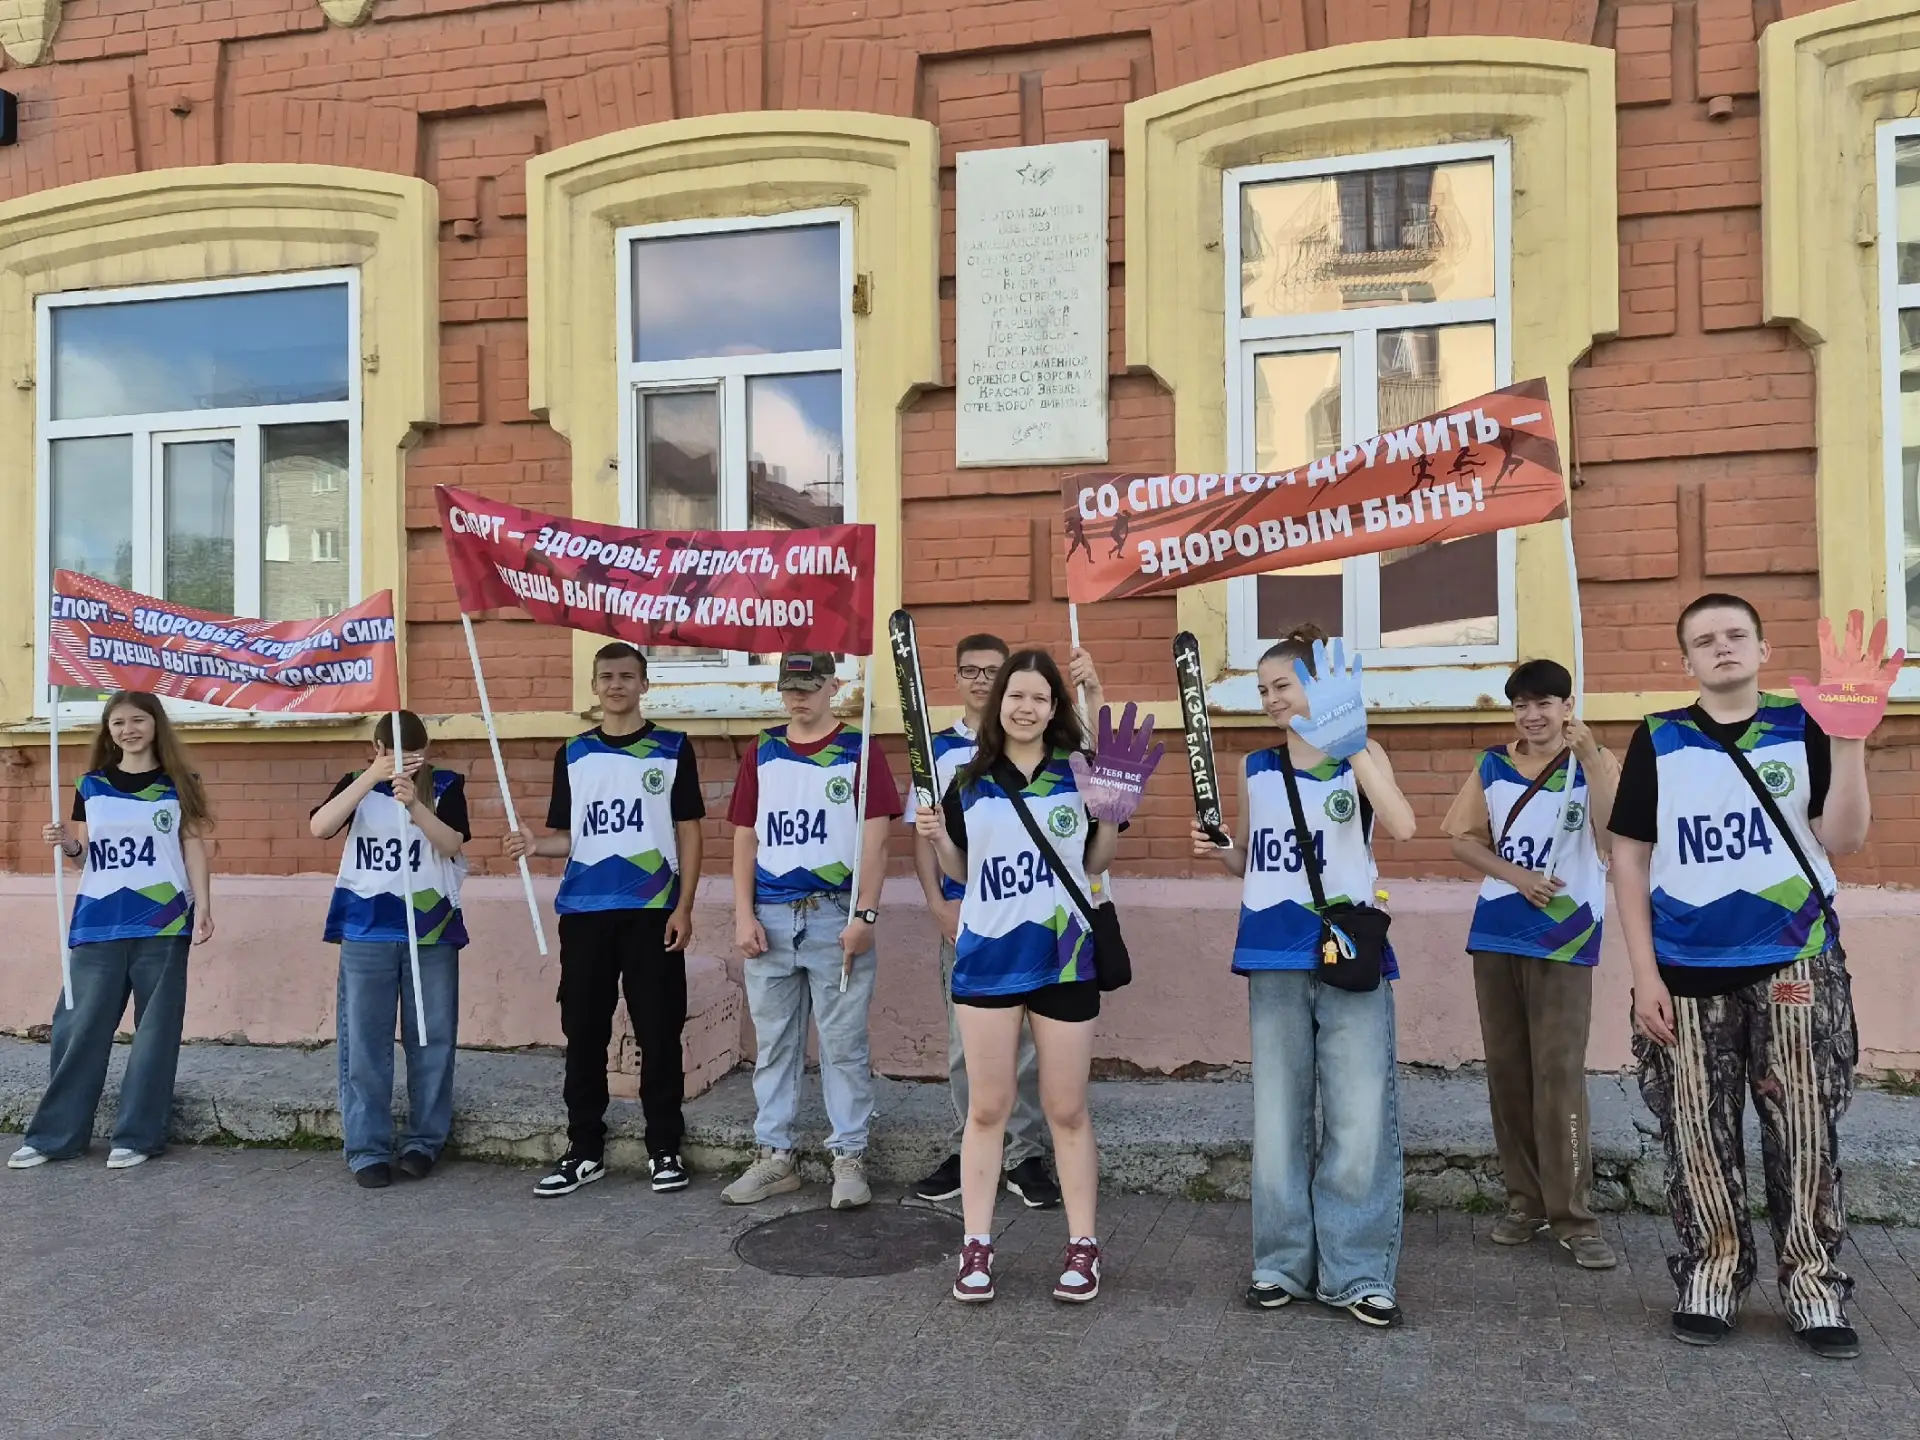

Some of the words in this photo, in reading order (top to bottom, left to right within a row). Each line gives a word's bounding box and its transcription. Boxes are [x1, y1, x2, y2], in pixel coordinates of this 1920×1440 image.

[1079, 484, 1119, 520] СО
[1307, 408, 1499, 487] ДРУЖИТЬ
[450, 506, 505, 544] СПОРТ
[534, 527, 663, 578] ЗДОРОВЬЕ,
[668, 547, 779, 579] КРЕПОСТЬ,
[1138, 505, 1353, 576] ЗДОРОВЫМ
[1362, 477, 1485, 532] БЫТЬ!
[494, 561, 559, 604] УДЕШЬ
[563, 578, 691, 624] ВЫГЛЯДЕТЬ
[695, 597, 814, 626] КРАСИВО!
[51, 596, 109, 622] СПОРТ
[134, 608, 244, 648] ЗДОРОВЬЕ,
[89, 637, 160, 667] БУДЕШЬ
[274, 659, 373, 686] КРАСИВО!
[1819, 692, 1878, 704] СДАВАЙСЯ!
[1842, 683, 1856, 691] НЕ
[1090, 776, 1142, 794] ПОЛУЧИТСЯ!
[1094, 765, 1101, 774] У
[1102, 767, 1123, 779] ТЕБЯ
[1186, 733, 1213, 800] БАСКЕТ
[583, 798, 644, 837] №34
[767, 808, 828, 847] №34
[1678, 807, 1773, 865] №34
[90, 836, 156, 872] №34
[356, 836, 421, 872] №34
[1250, 828, 1327, 874] №34
[981, 850, 1054, 902] №34
